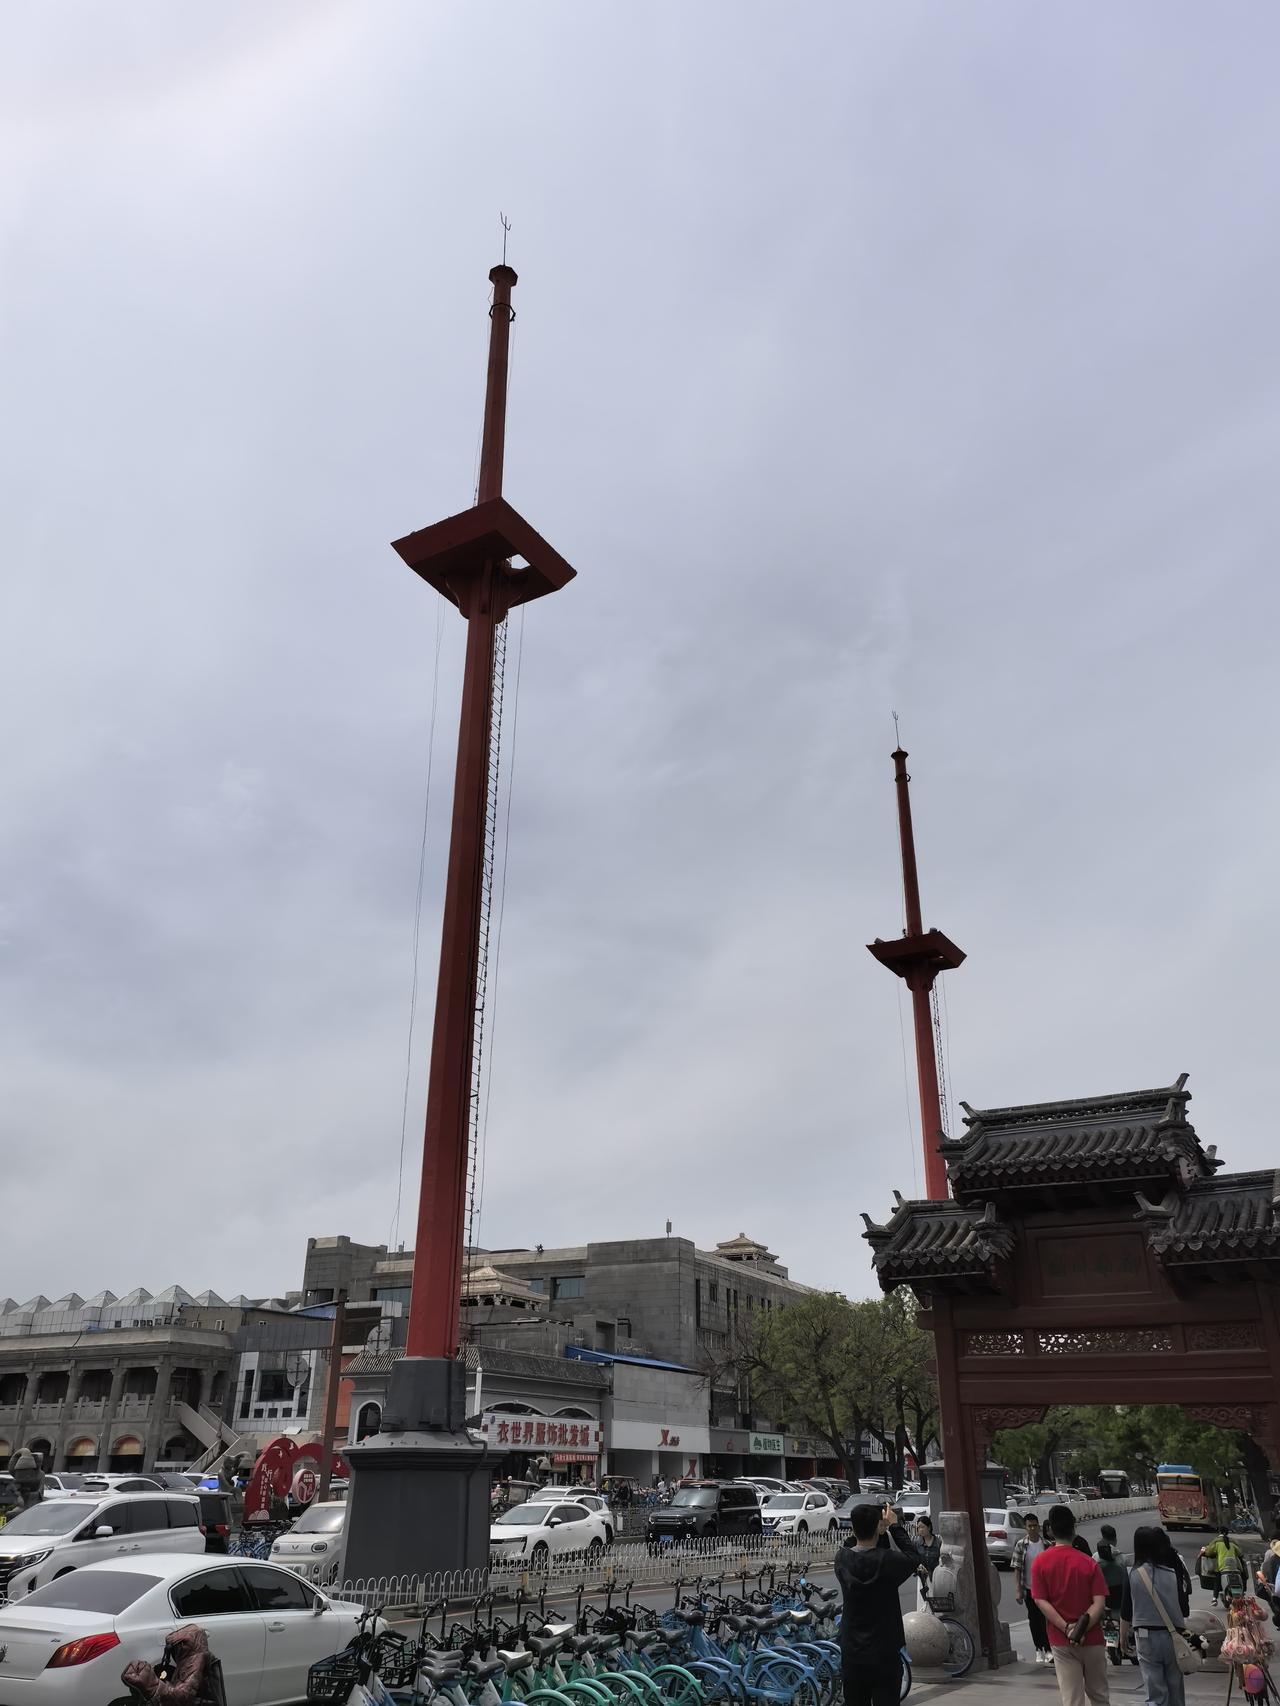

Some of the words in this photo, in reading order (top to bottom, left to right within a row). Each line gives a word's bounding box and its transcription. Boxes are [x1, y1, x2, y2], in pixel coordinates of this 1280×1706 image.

[497, 1420, 589, 1446] 衣世界服饰批发城
